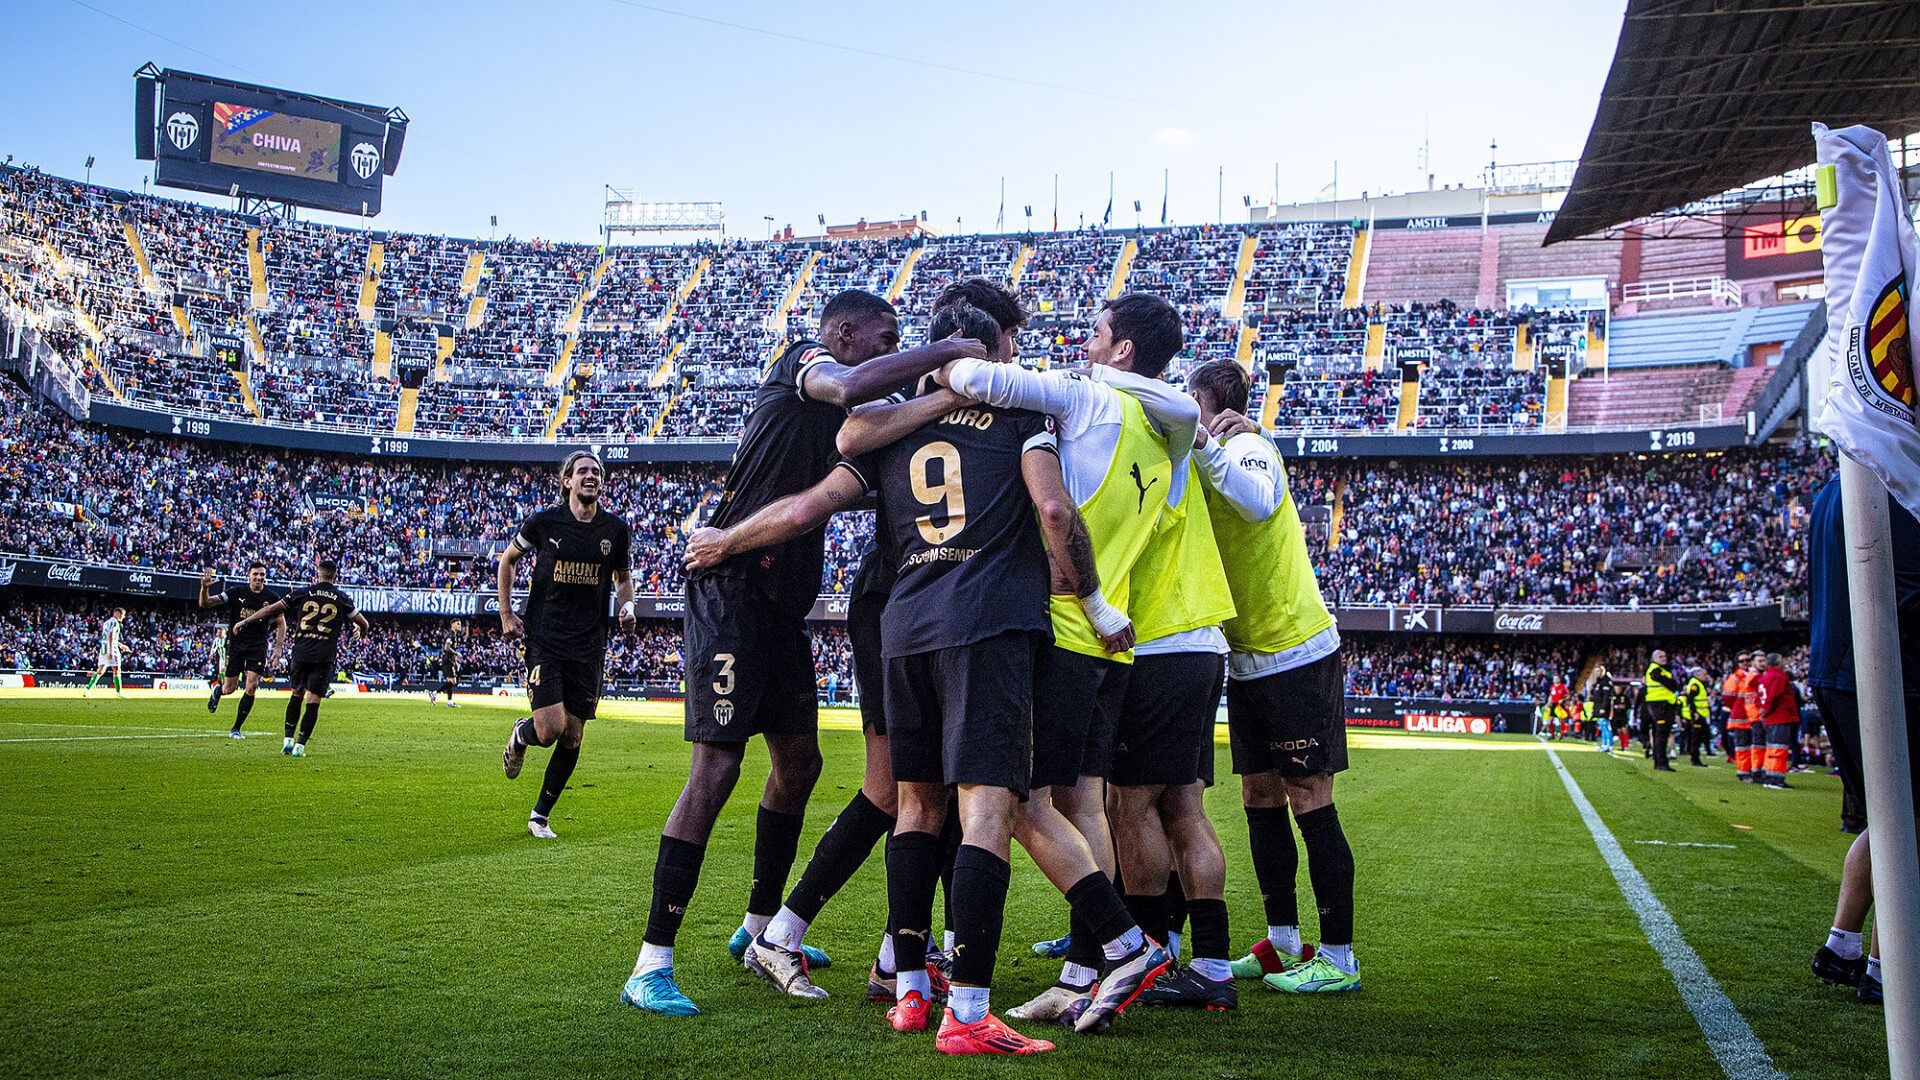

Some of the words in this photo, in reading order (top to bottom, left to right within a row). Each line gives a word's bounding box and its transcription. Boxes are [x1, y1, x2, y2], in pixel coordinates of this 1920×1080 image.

[253, 132, 301, 153] CHIVA
[1407, 218, 1448, 229] AMSTEL
[211, 337, 241, 348] AMSTEL
[1541, 344, 1575, 354] AMSTEL
[1266, 352, 1297, 361] AMSTEL
[1398, 349, 1429, 358] AMSTEL
[399, 357, 428, 367] AMSTEL
[1850, 354, 1863, 381] CAMP
[1859, 384, 1872, 398] DE
[186, 420, 210, 435] 1999
[1311, 439, 1338, 452] 2004
[1451, 439, 1474, 450] 2008
[1665, 431, 1695, 447] 2019
[383, 440, 409, 453] 1999
[606, 447, 629, 459] 2002
[1240, 457, 1267, 470] ina
[909, 440, 966, 545] 9
[940, 547, 981, 562] SEMP
[554, 559, 601, 576] AMUNT
[129, 573, 152, 583] divina
[553, 572, 600, 585] VALENCIANS
[316, 590, 338, 600] RIOJA
[411, 591, 476, 614] MESTALLA
[655, 602, 685, 611] SKOD
[828, 601, 849, 614] divi
[300, 600, 338, 634] 22
[712, 652, 736, 695] 3
[1406, 715, 1467, 733] LALIGA
